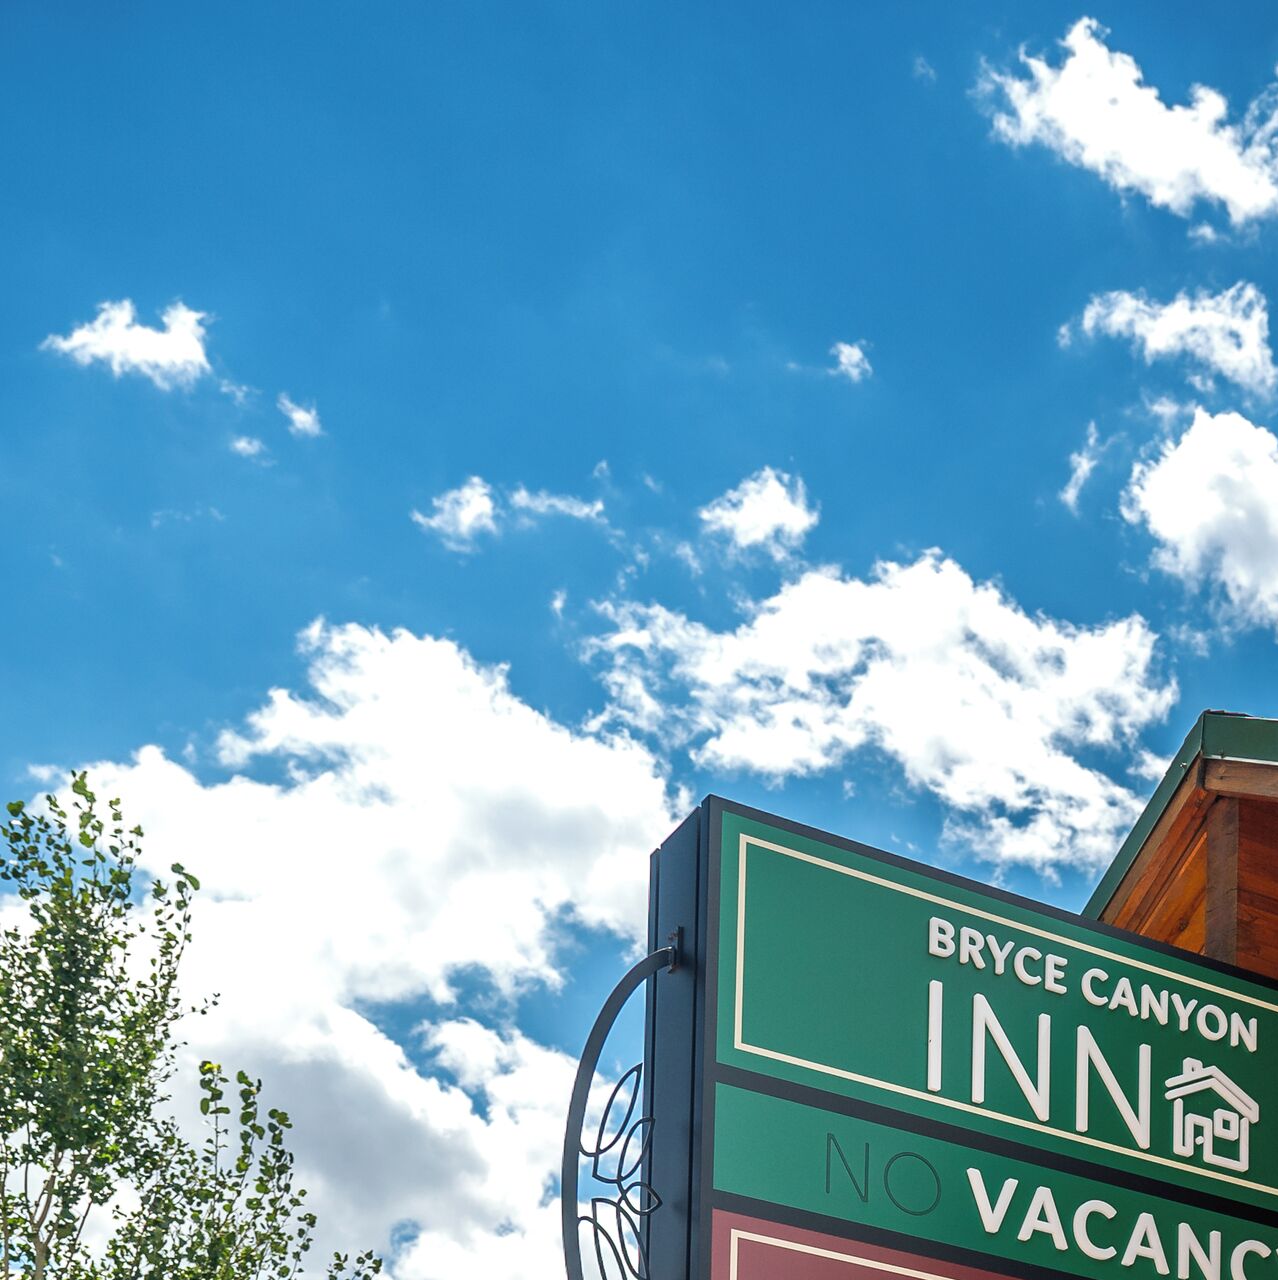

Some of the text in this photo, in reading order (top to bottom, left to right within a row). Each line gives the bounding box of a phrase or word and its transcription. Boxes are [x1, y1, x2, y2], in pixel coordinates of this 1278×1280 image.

[929, 917, 1258, 1053] BRYCE CANYON
[926, 980, 1151, 1149] INN
[825, 1132, 942, 1215] NO
